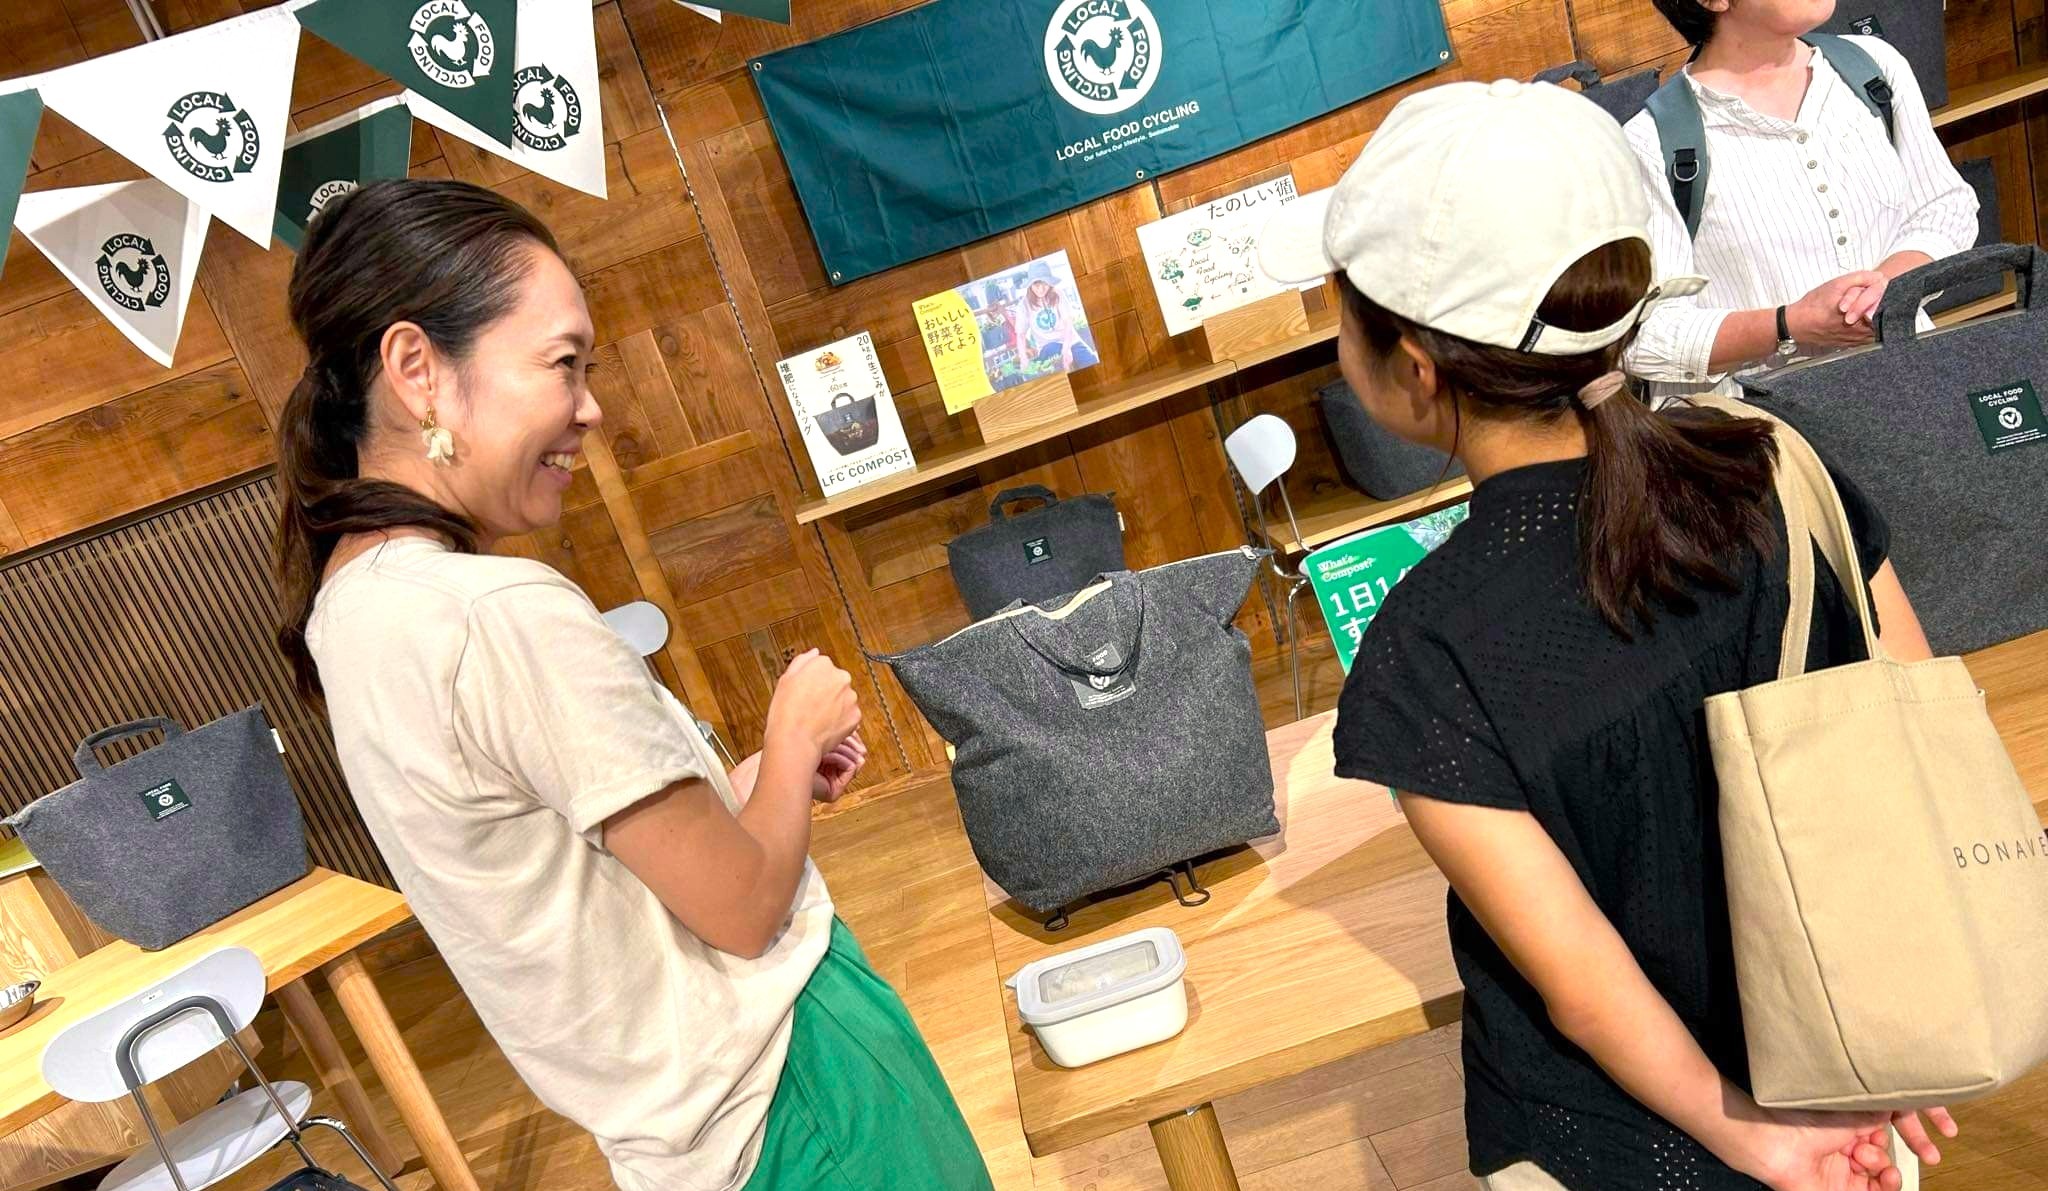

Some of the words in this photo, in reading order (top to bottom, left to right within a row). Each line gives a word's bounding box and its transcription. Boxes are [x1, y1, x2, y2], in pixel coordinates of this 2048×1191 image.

[415, 2, 459, 28] LOCAL
[1067, 1, 1120, 30] LOCAL
[474, 23, 491, 66] FOOD
[1131, 28, 1148, 80] FOOD
[414, 46, 467, 85] CYCLING
[1059, 49, 1112, 99] CYCLING
[172, 93, 225, 119] LOCAL
[513, 68, 544, 90] OCAL
[560, 84, 579, 126] FOOD
[240, 119, 257, 164] FOOD
[1056, 136, 1101, 160] LOCAL
[1102, 121, 1140, 144] FOOD
[1142, 100, 1200, 129] CYCLING
[168, 135, 226, 180] CYCLING
[106, 235, 147, 252] LOCAL
[99, 265, 140, 309] CYCLING
[153, 264, 168, 301] FOOD
[924, 308, 970, 330] おいしい
[927, 323, 964, 345] 野菜を
[932, 333, 976, 358] 育てよう
[1979, 392, 2003, 403] LOCAL
[822, 471, 845, 487] LFC
[848, 449, 908, 478] COMPOST
